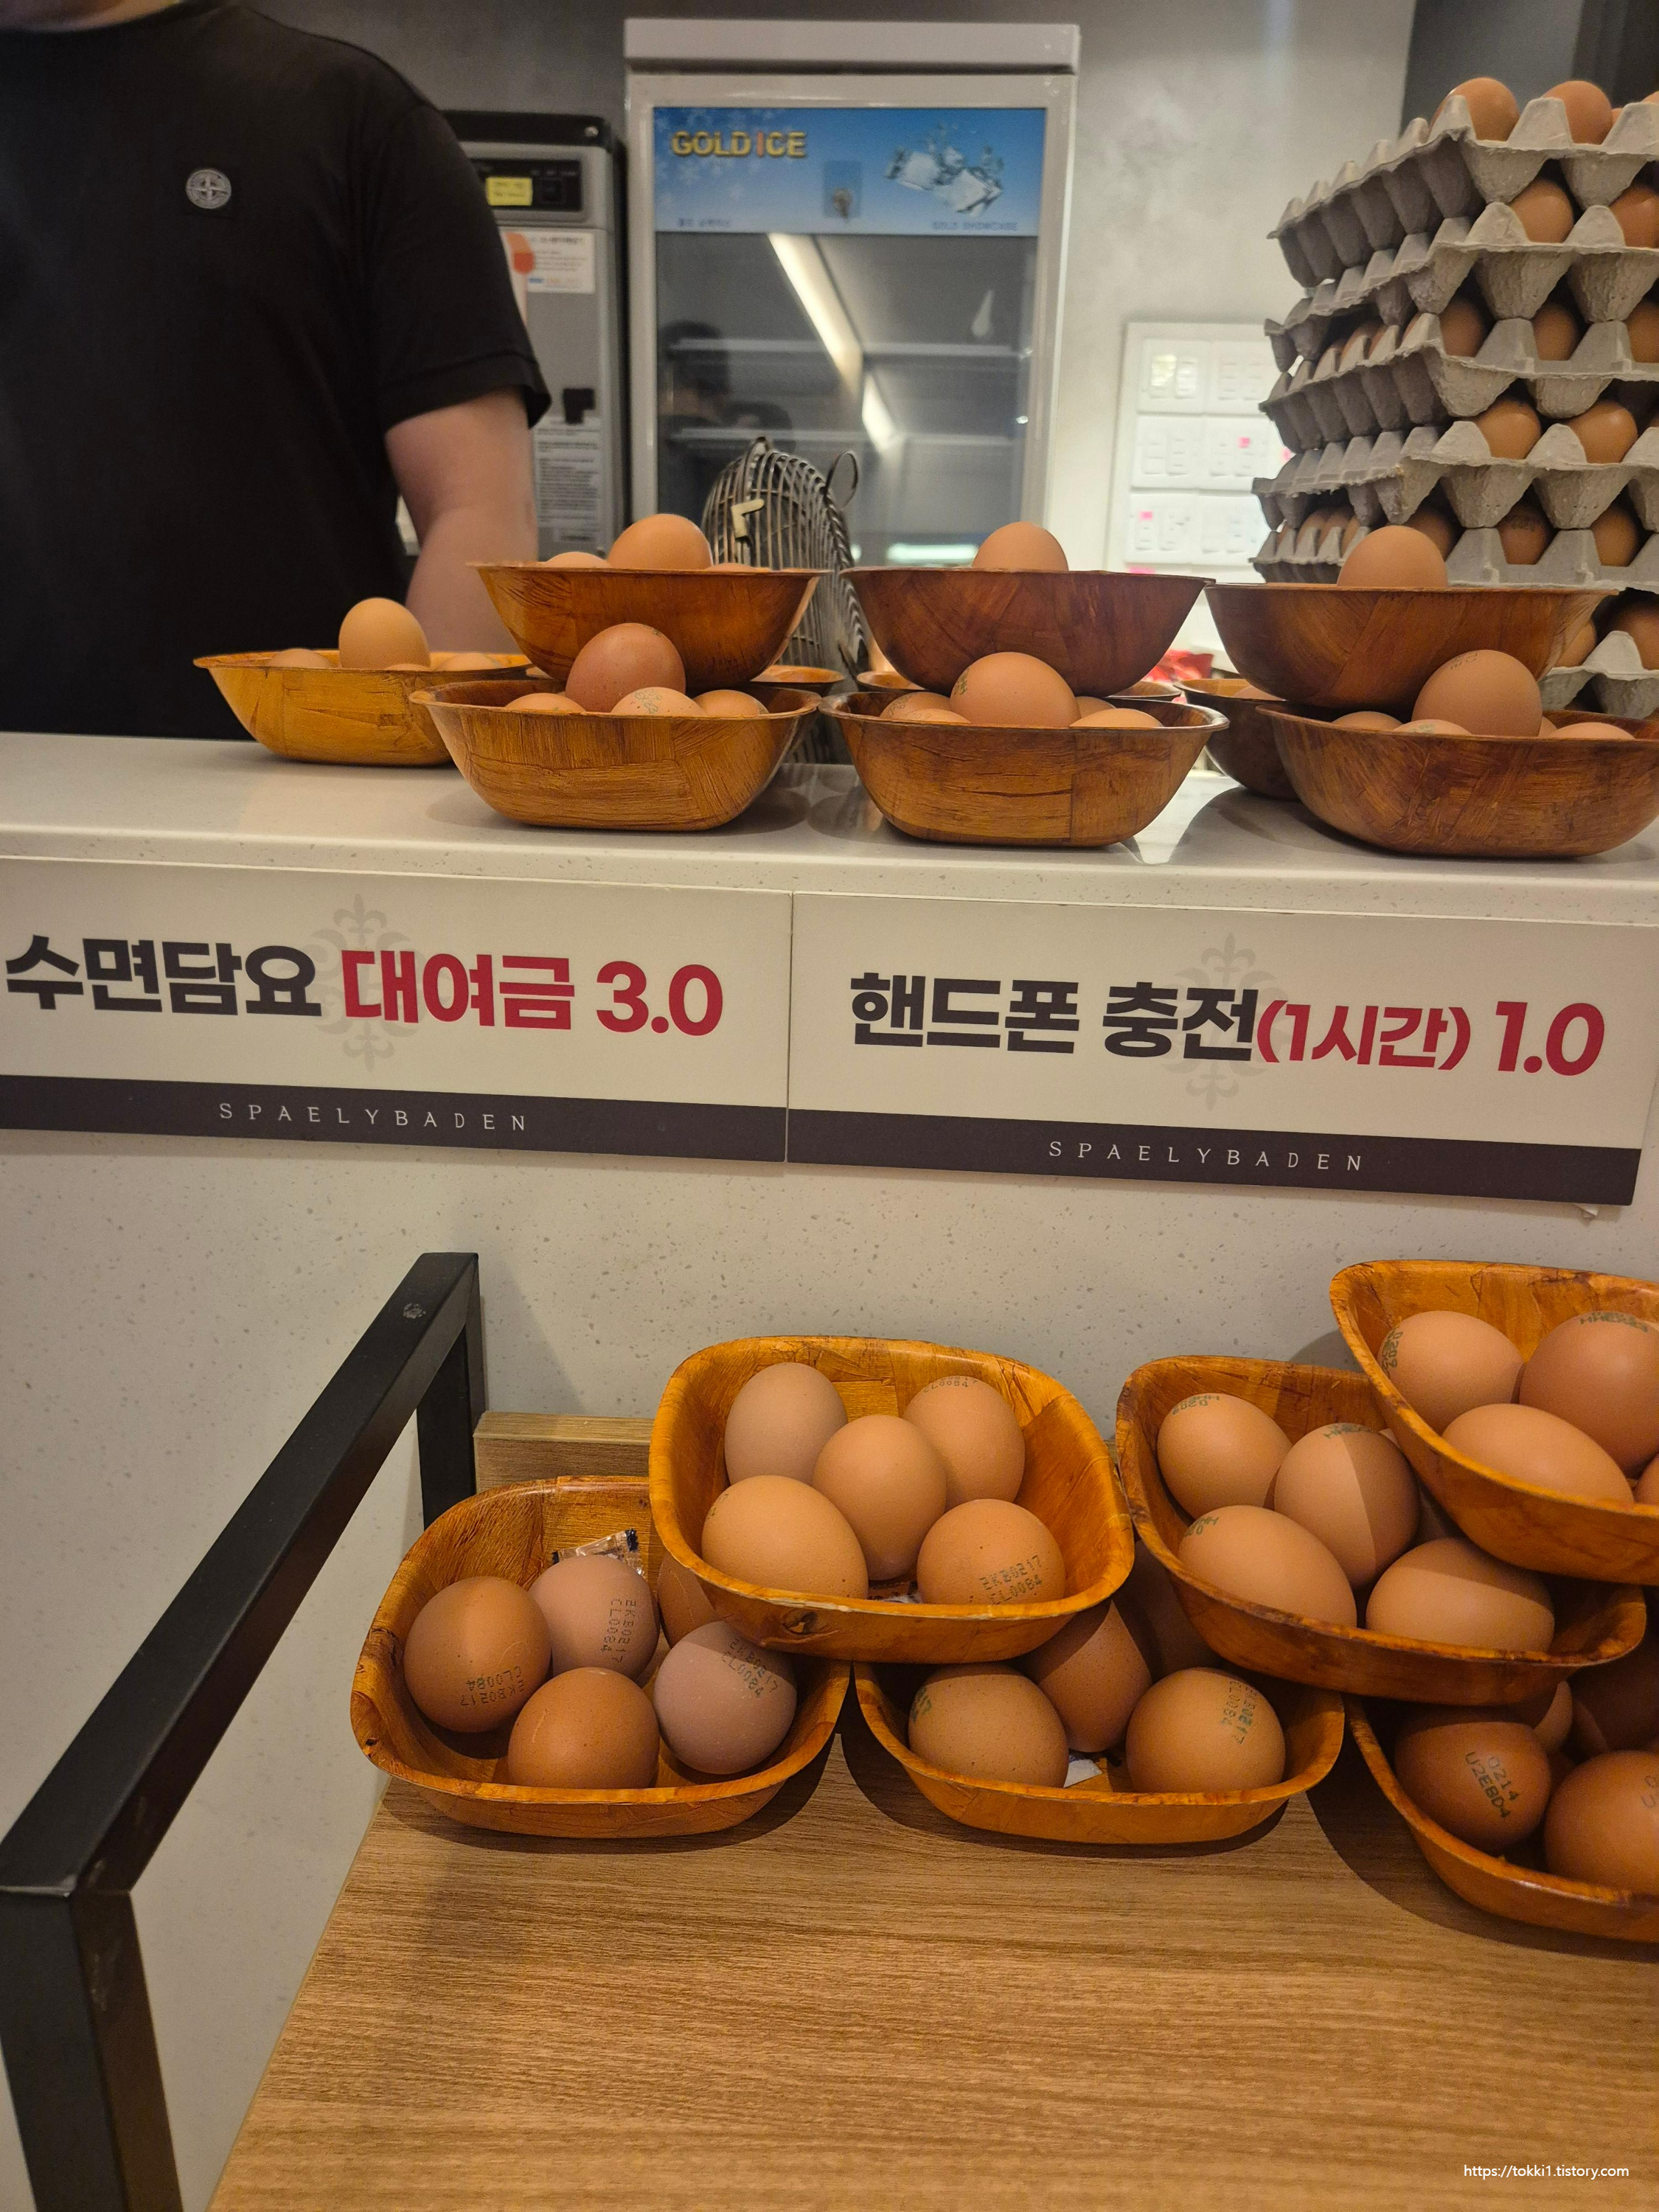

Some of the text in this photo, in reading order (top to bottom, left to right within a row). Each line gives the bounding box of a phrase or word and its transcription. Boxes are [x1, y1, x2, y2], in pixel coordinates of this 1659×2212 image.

[672, 130, 807, 158] GOLD ICE
[5, 935, 723, 1037] 수면담요 대여금 3.0
[850, 973, 1079, 1054] 핸드폰
[1495, 1001, 1605, 1076] 1.0
[219, 1102, 527, 1132] SPAELYBADEN
[1049, 1140, 1363, 1170] SPAELYBADEN
